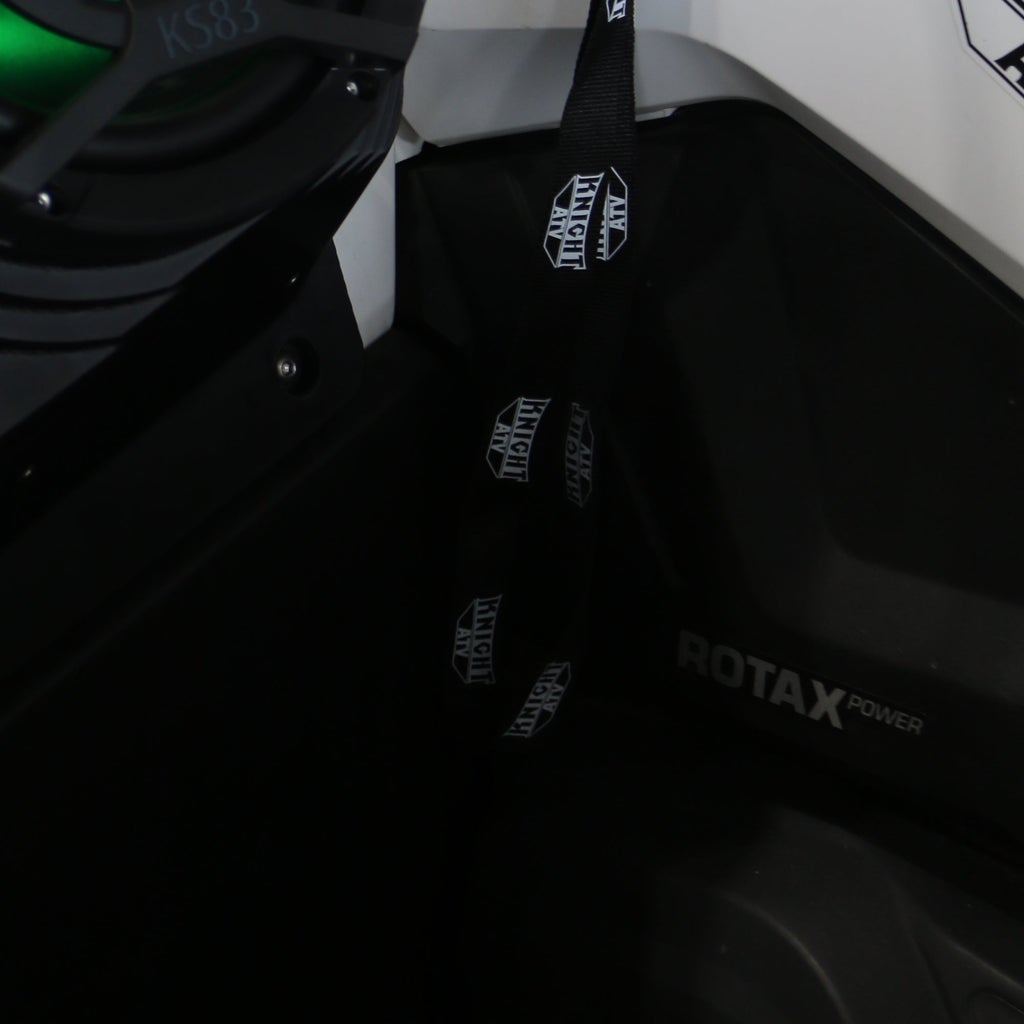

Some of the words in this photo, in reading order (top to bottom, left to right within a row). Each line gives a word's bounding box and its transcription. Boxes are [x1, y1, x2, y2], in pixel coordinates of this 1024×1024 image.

[548, 207, 569, 240] ATV
[560, 175, 602, 267] KNIGHT
[609, 195, 626, 231] ATV
[491, 422, 511, 454] ATV
[502, 399, 549, 481] KNIGHT
[455, 627, 472, 658] ATV
[470, 595, 501, 683] KNIGHT
[677, 628, 847, 730] ROTAX
[847, 693, 926, 736] POWER
